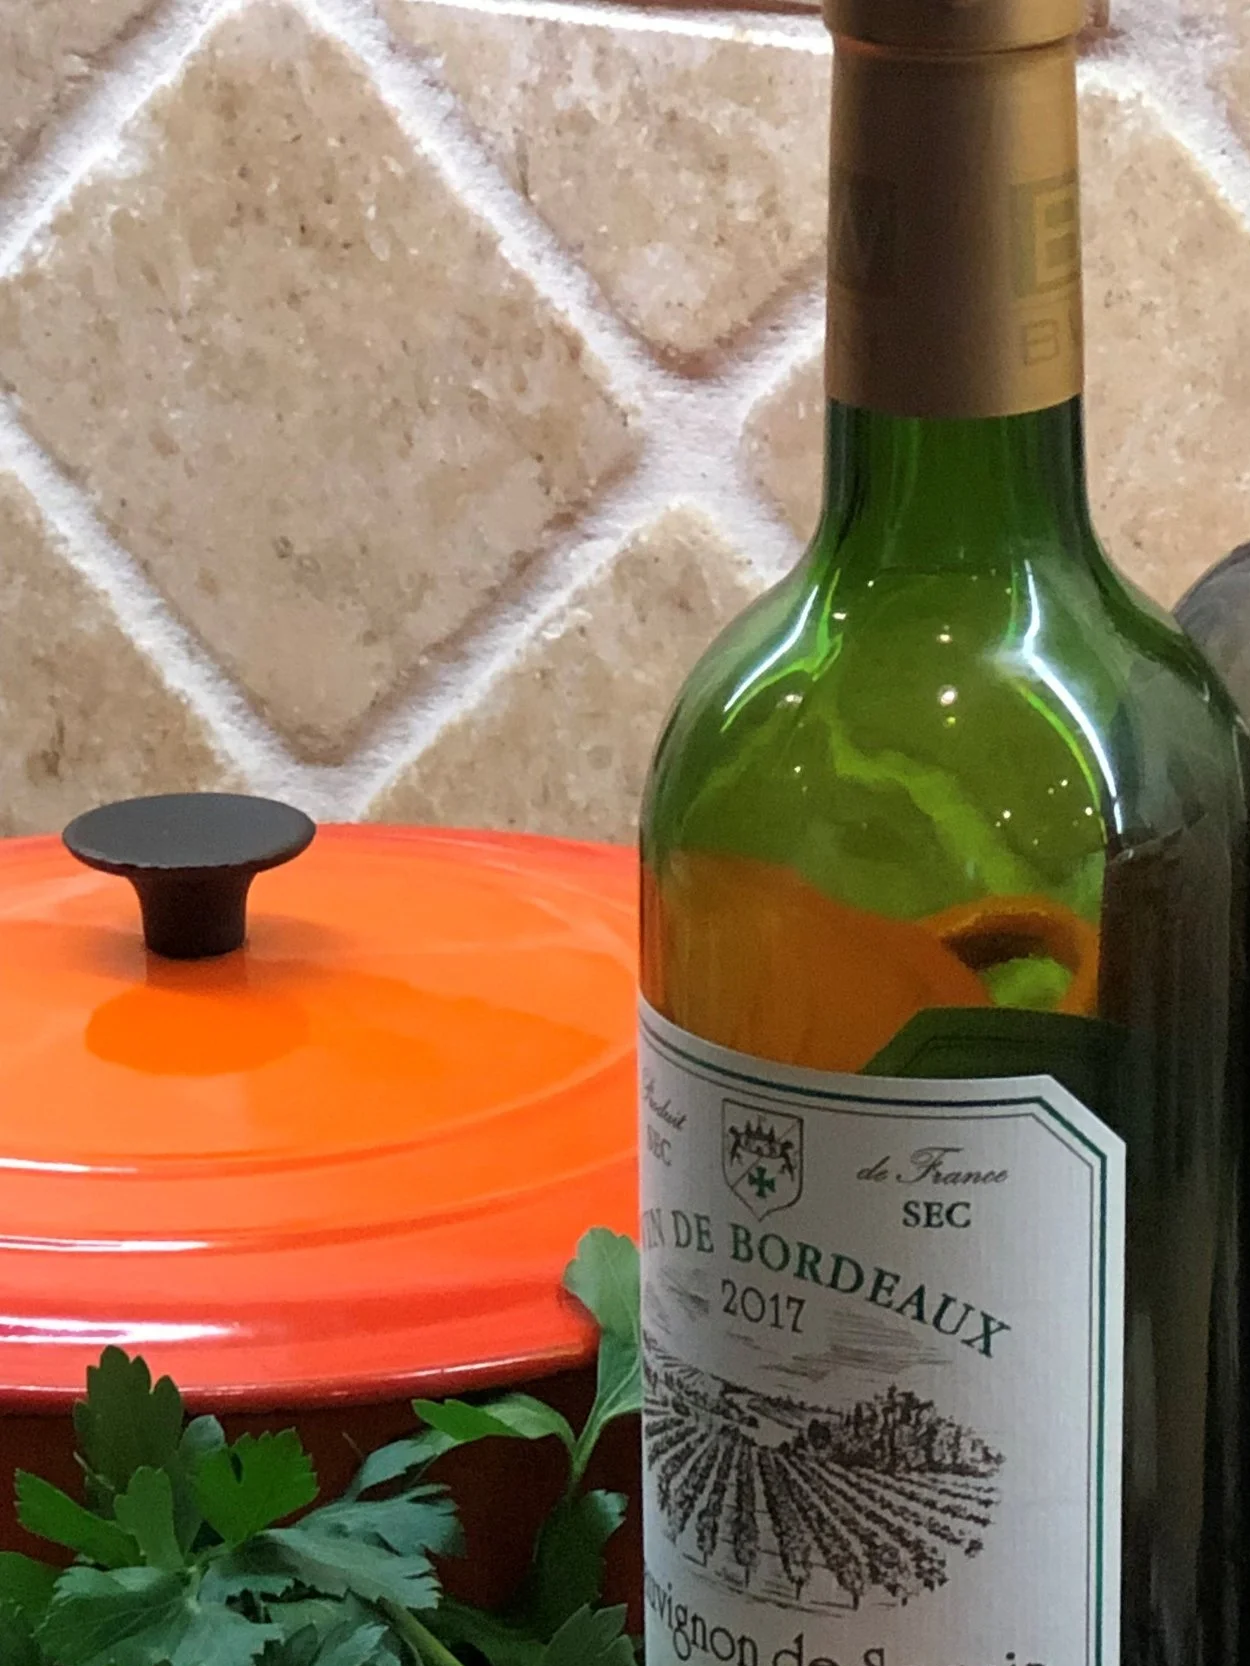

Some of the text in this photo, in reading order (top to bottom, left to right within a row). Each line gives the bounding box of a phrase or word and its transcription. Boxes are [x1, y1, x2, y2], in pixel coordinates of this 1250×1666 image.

[857, 1155, 892, 1183] de
[896, 1146, 1009, 1185] France
[902, 1200, 972, 1229] SEC
[671, 1209, 714, 1253] DE
[729, 1222, 1011, 1359] BORDEAUX
[721, 1278, 806, 1334] 2017
